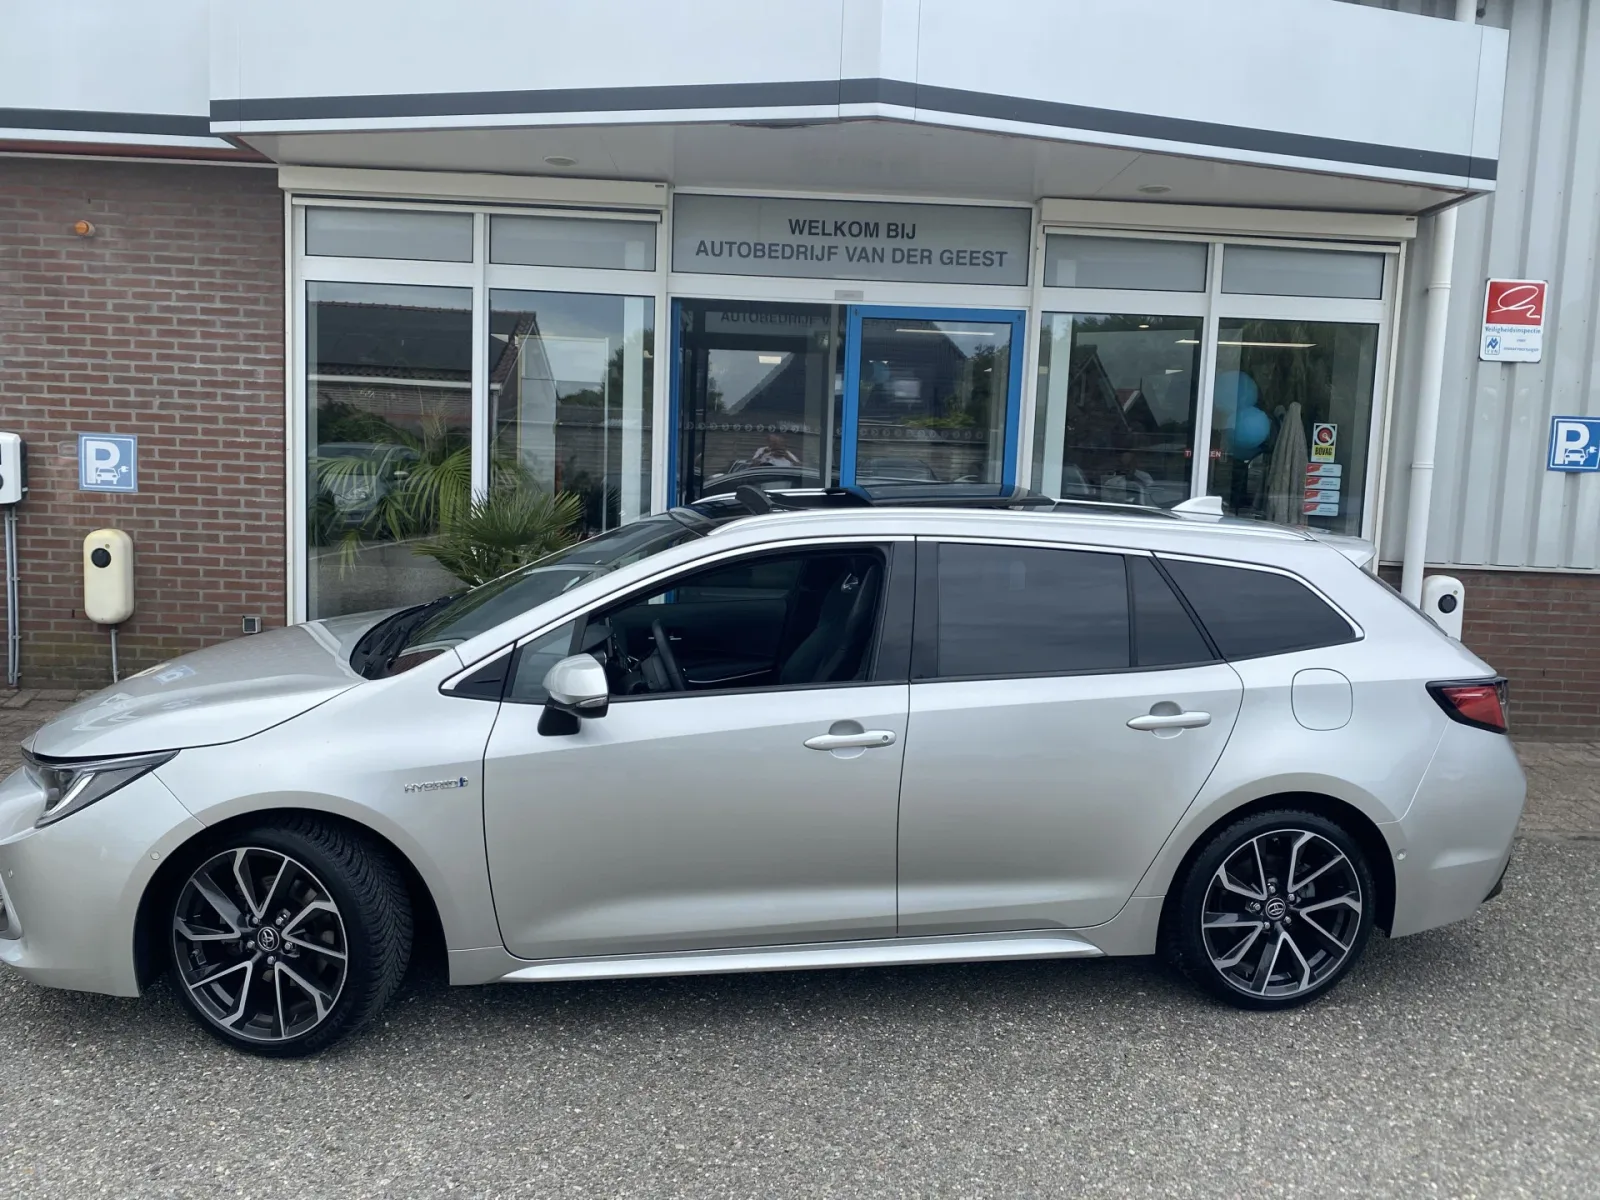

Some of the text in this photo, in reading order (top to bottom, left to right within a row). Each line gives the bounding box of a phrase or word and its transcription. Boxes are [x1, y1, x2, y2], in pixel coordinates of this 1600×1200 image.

[788, 218, 916, 240] WELKOM BIJ
[695, 240, 1008, 268] AUTOBEDRIJF VAN DER GEEST
[1314, 447, 1333, 456] BOVAG
[1554, 422, 1590, 465] P
[86, 441, 120, 484] P
[404, 779, 458, 793] HYBRID
